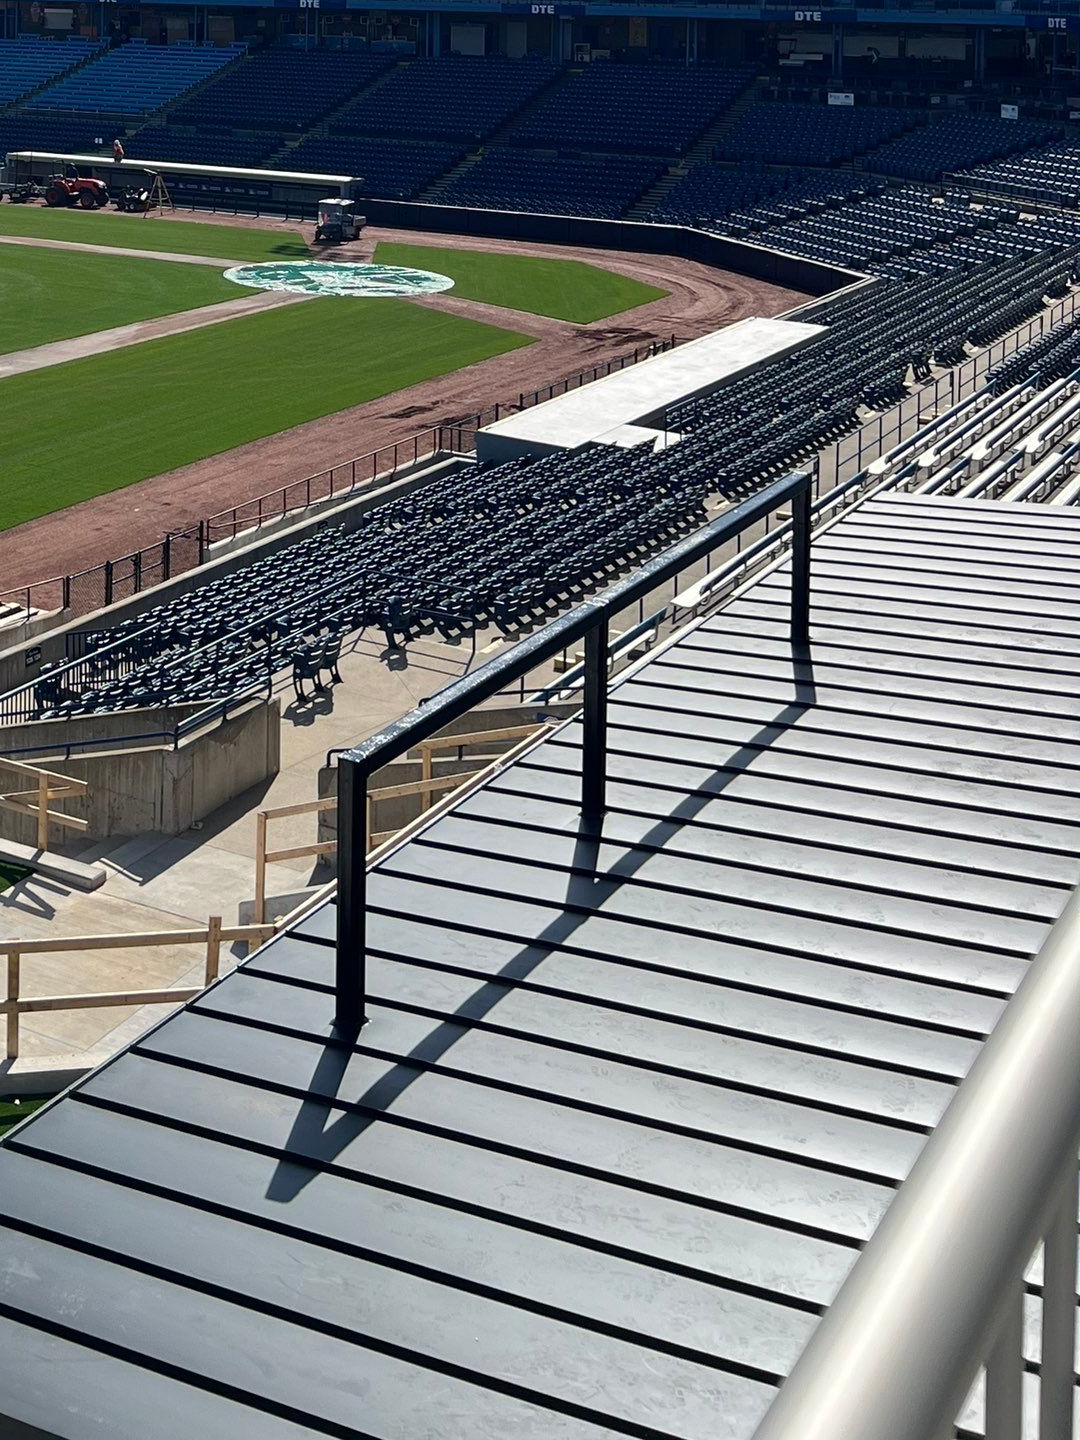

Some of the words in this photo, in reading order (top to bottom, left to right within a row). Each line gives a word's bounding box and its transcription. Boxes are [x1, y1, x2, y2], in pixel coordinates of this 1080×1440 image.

[299, 0, 320, 8] DTE
[531, 4, 555, 14] DTE
[794, 11, 822, 21] DTE
[1047, 17, 1067, 29] DTE
